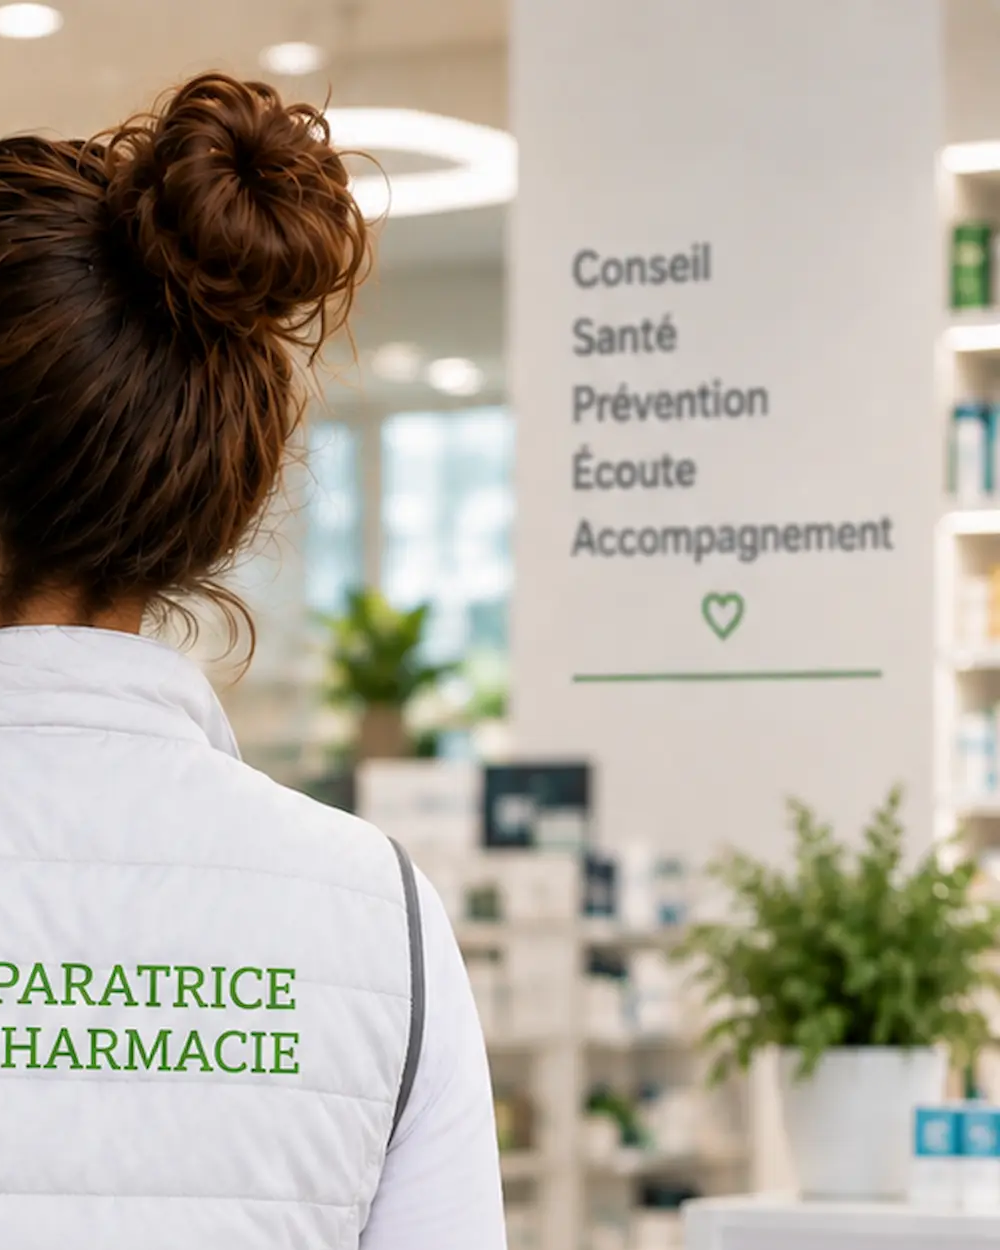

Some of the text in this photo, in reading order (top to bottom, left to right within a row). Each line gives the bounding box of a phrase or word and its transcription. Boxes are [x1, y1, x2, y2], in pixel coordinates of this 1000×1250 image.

[571, 241, 712, 289] Conseil
[572, 313, 678, 357] Santé
[572, 378, 769, 423] Prévention
[572, 444, 697, 490] Écoute
[570, 516, 894, 564] Accompagnement
